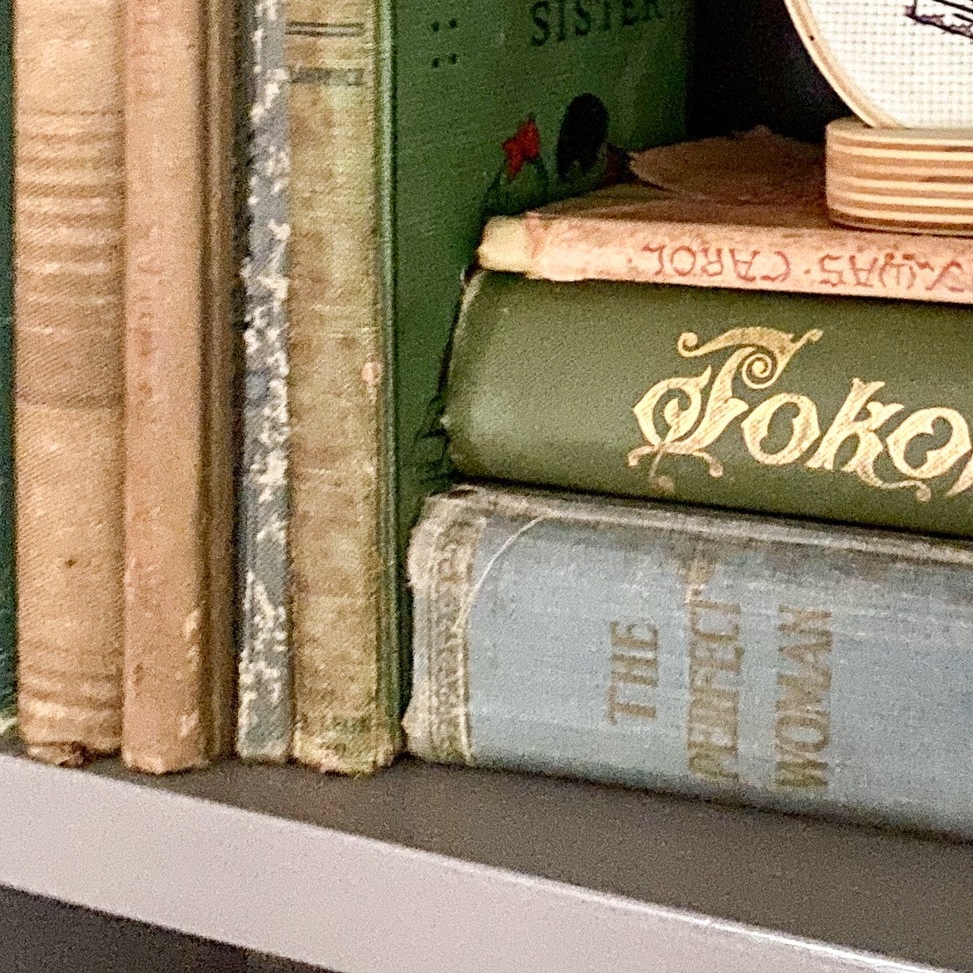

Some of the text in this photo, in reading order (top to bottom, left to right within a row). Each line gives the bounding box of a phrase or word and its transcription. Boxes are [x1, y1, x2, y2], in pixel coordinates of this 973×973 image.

[641, 244, 791, 284] CAROL
[604, 622, 659, 725] THE
[775, 603, 833, 790] WOMAN
